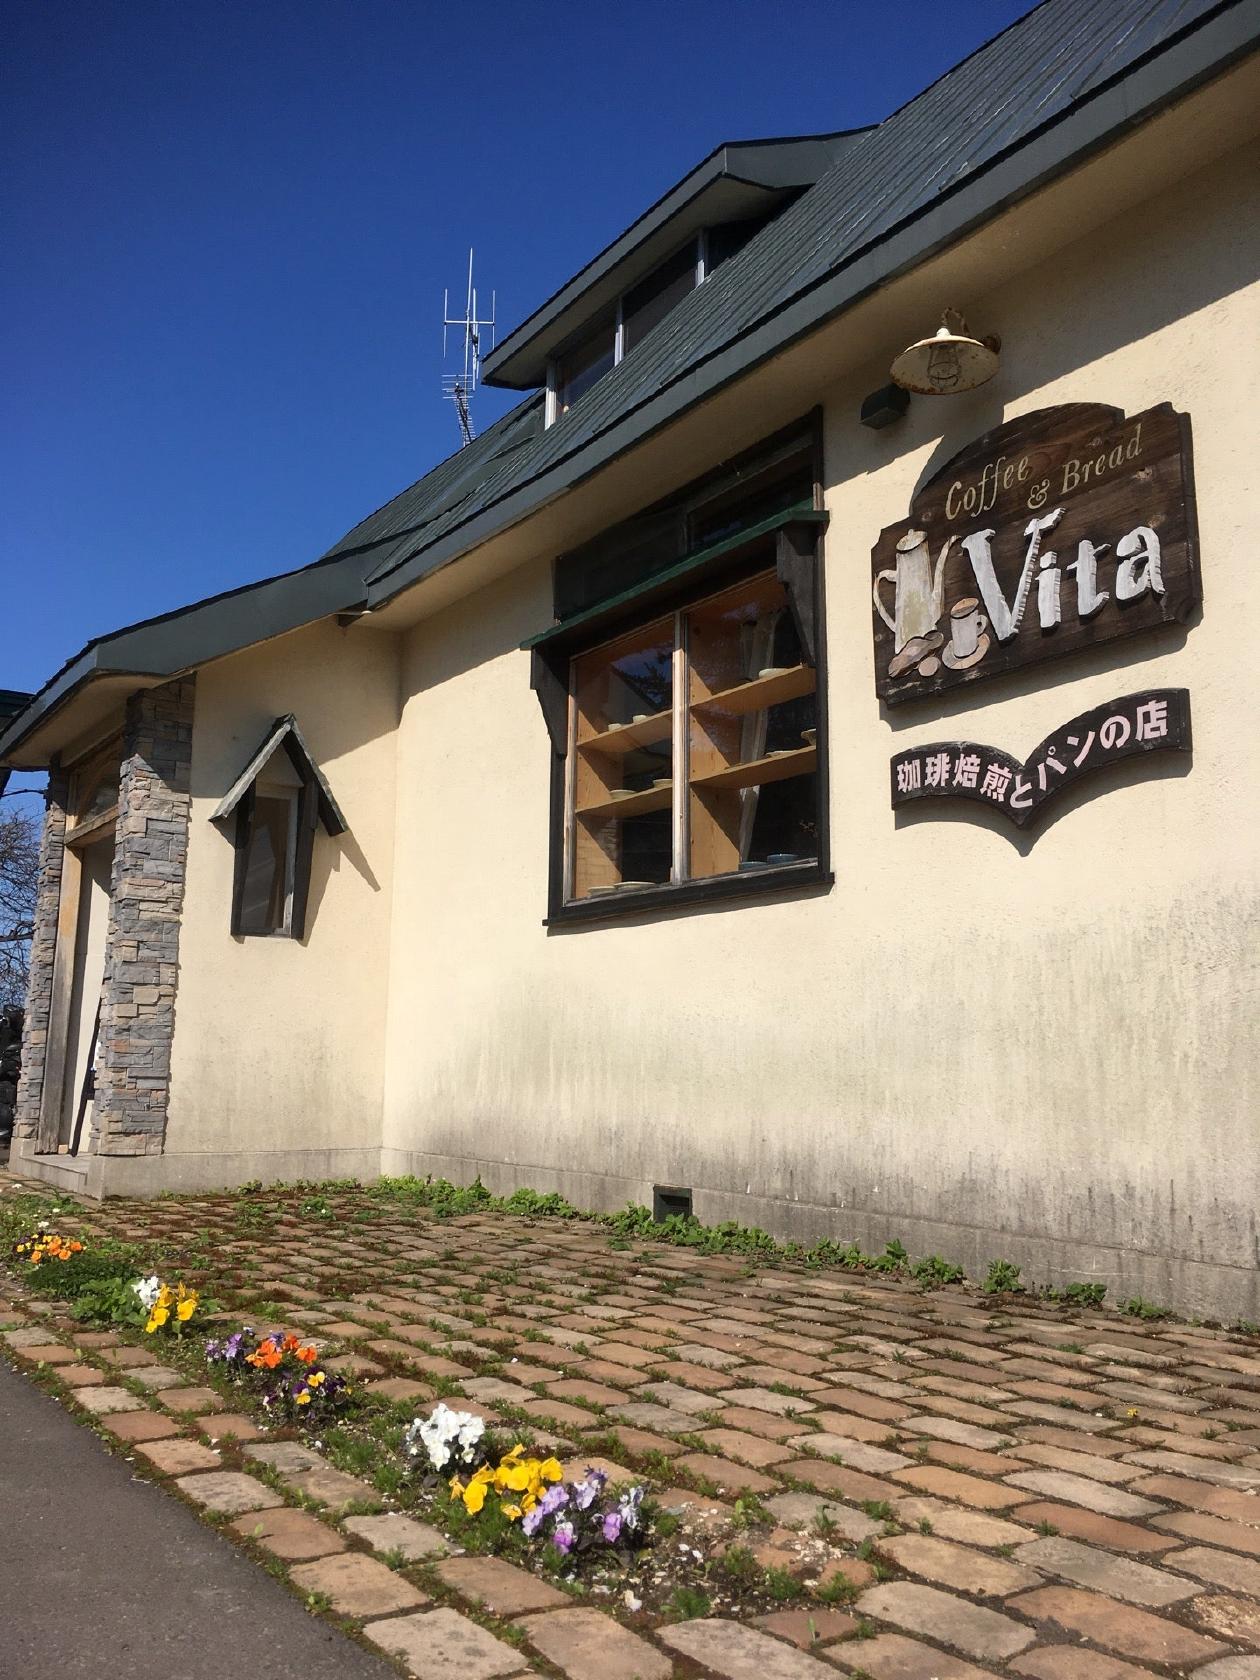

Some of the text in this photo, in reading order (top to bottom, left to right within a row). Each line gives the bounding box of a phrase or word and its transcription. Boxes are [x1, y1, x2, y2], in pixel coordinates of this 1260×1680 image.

[945, 423, 1143, 520] Coffee & Bread
[960, 507, 1166, 641] Vita
